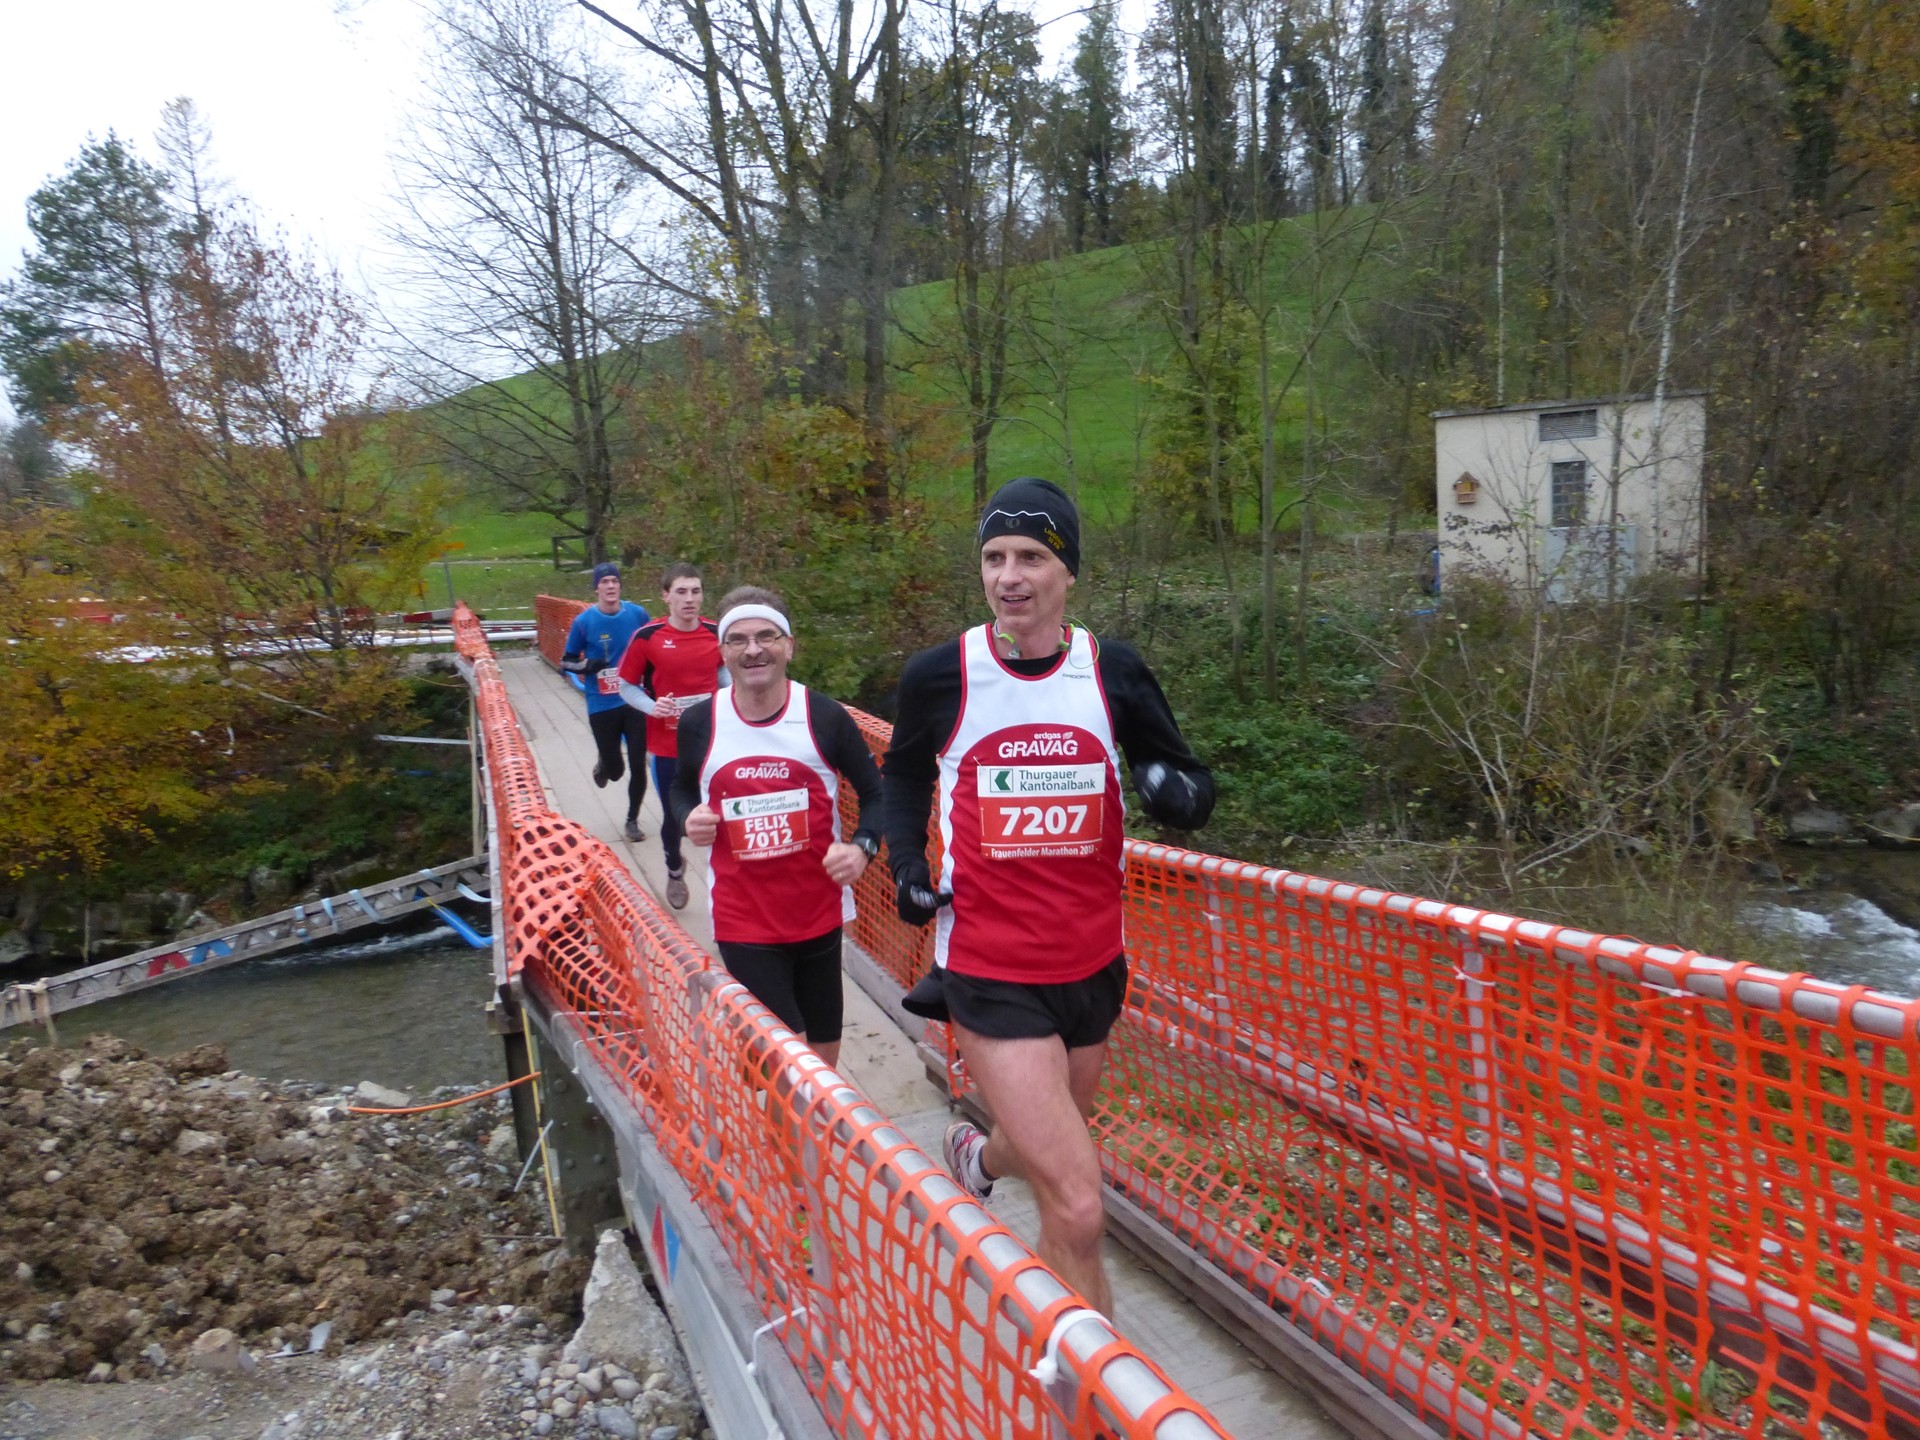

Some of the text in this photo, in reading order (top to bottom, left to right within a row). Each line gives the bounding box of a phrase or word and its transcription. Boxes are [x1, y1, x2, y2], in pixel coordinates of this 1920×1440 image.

[1034, 731, 1062, 740] erdgas
[998, 740, 1079, 758] GRAVAG
[735, 767, 789, 779] GRAVAG
[1019, 769, 1077, 782] Thurgauer
[1020, 779, 1096, 792] Kantonalbank
[748, 796, 786, 807] Thurgauer
[749, 802, 800, 813] Kantonalbank
[745, 814, 789, 833] FELIX
[999, 804, 1088, 837] 7207
[745, 829, 793, 850] 7012
[991, 847, 1039, 858] Frauenfelder
[1041, 846, 1078, 857] Marathon
